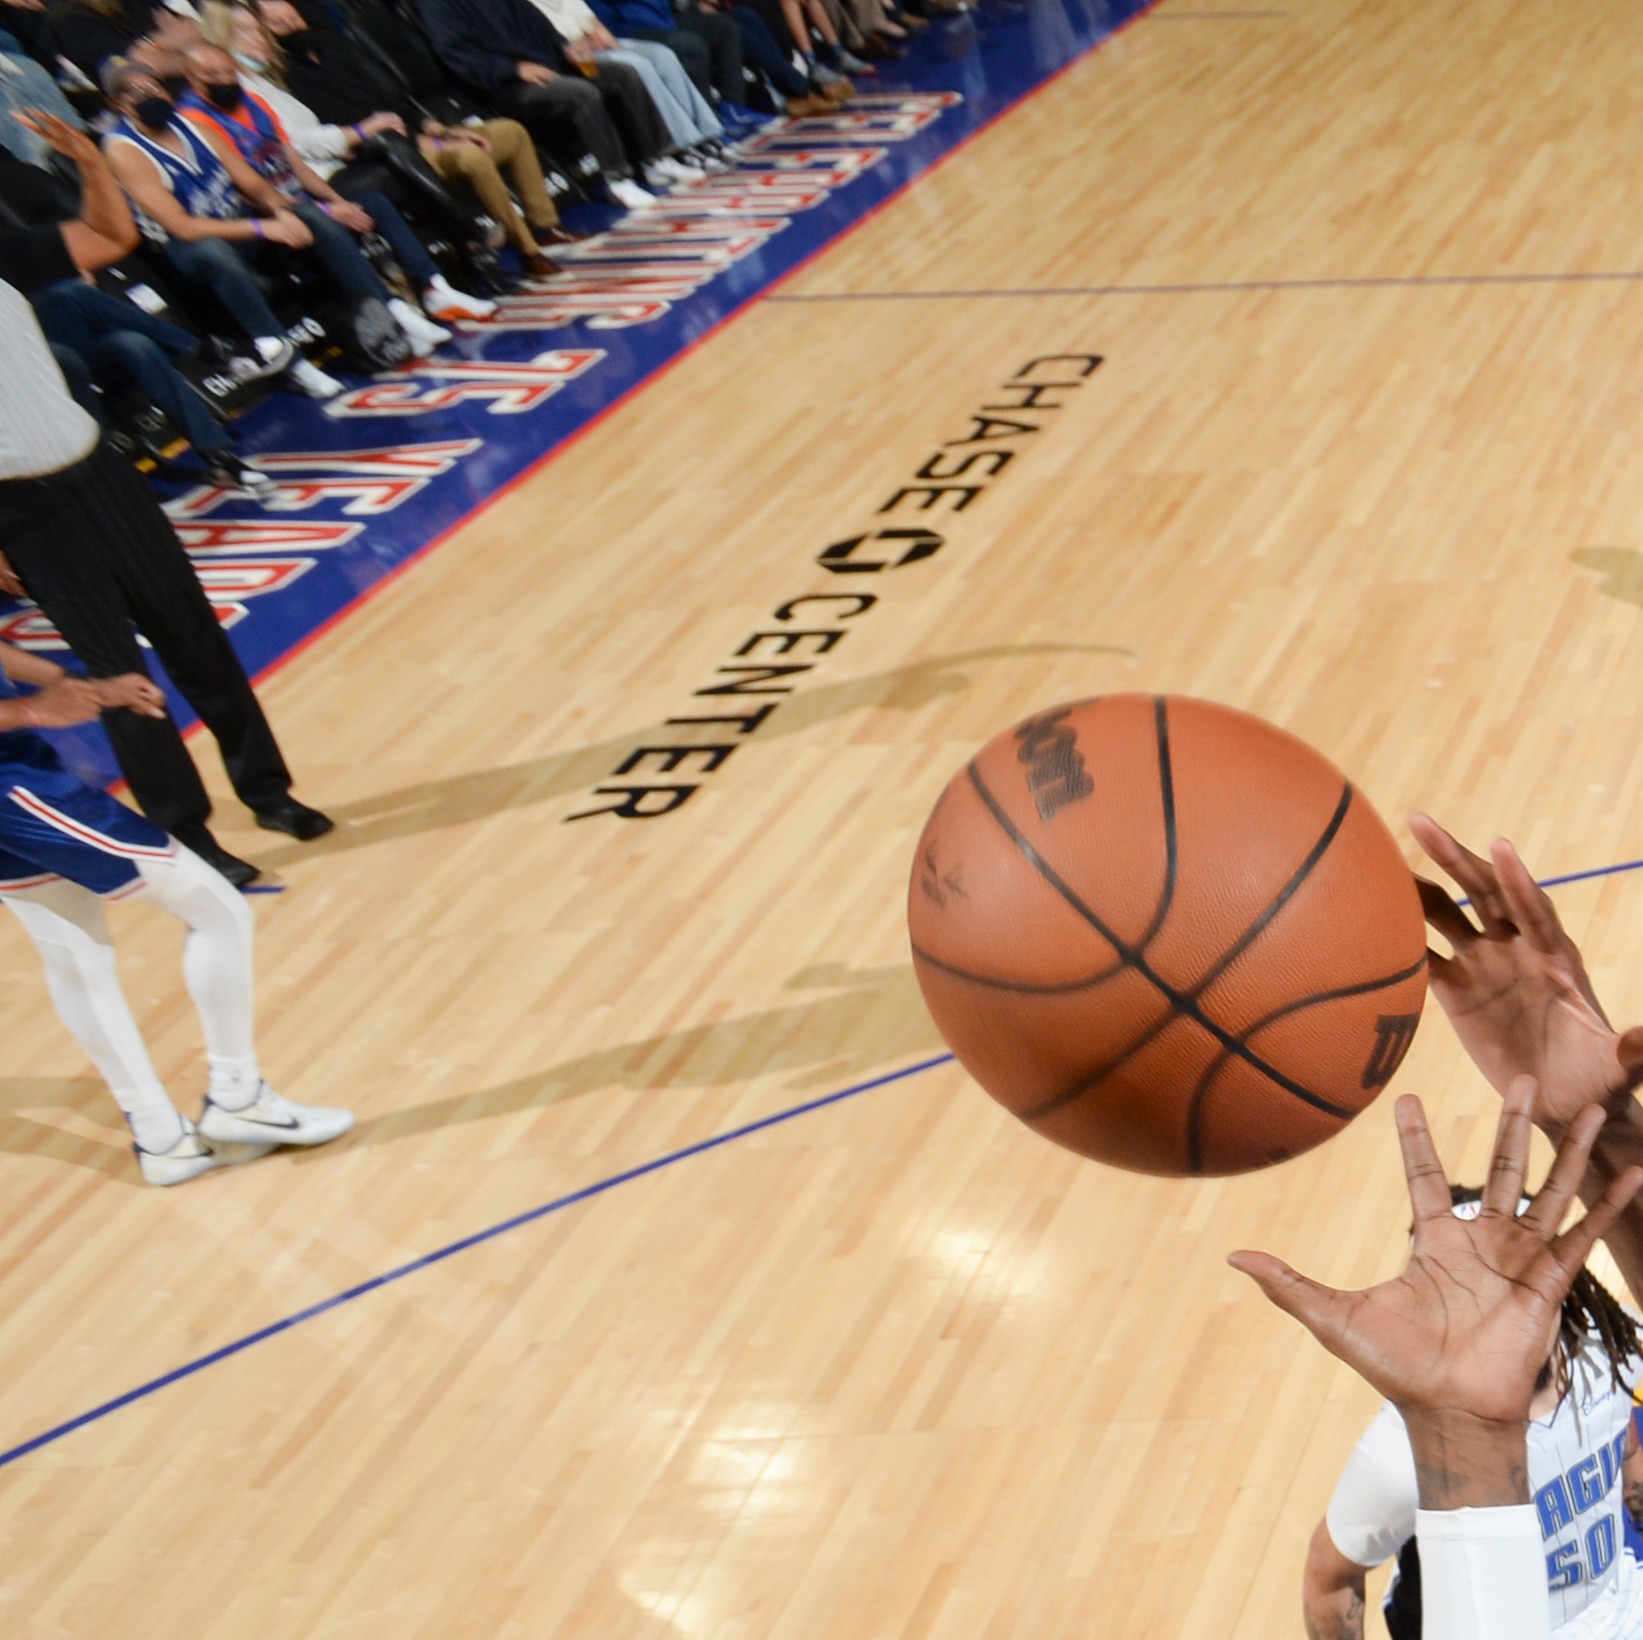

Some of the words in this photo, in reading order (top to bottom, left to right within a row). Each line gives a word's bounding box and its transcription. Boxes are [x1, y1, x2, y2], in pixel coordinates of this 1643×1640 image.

[322, 349, 608, 418] 75
[876, 353, 1105, 514] CHASE
[561, 593, 879, 823] CENTER
[1546, 1513, 1616, 1591] 50
